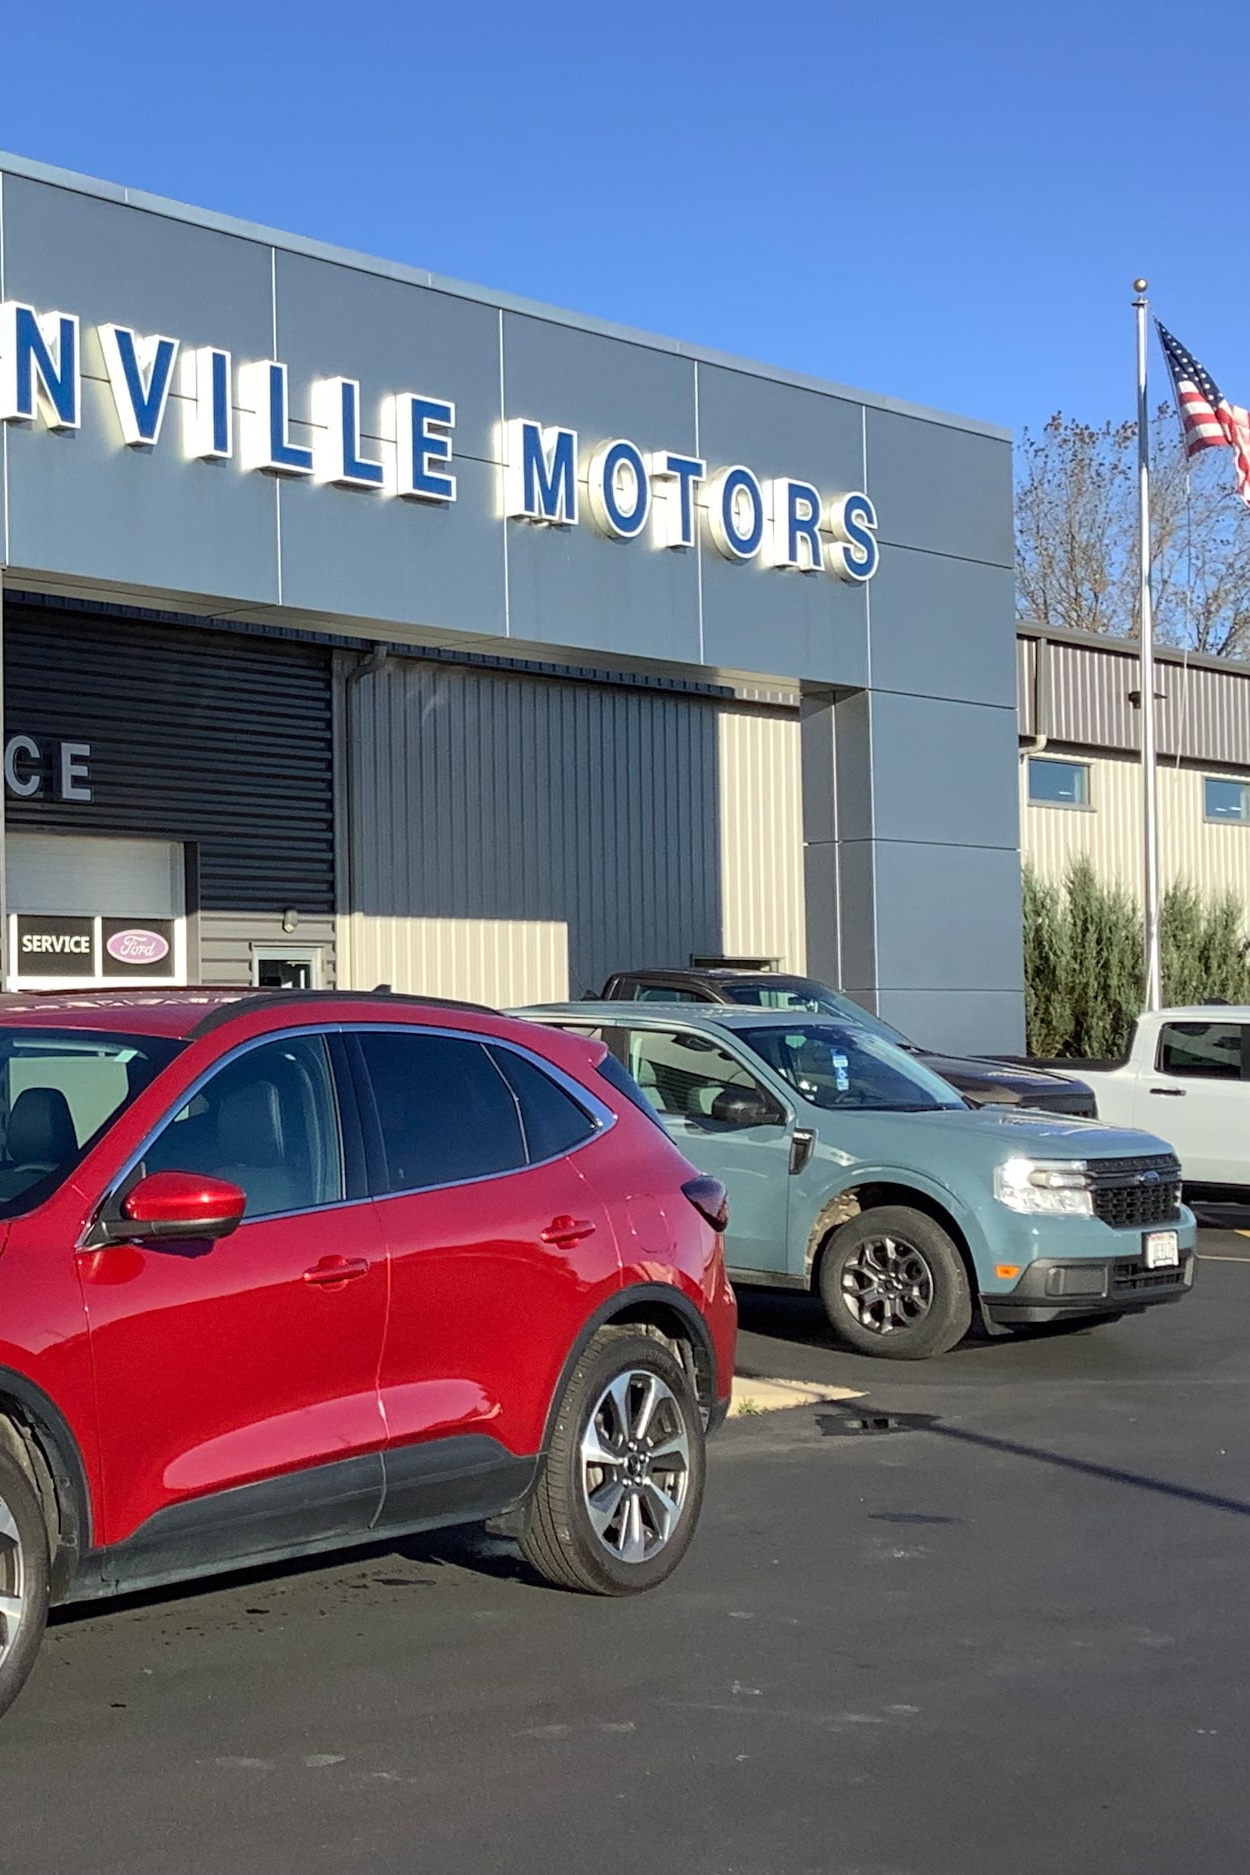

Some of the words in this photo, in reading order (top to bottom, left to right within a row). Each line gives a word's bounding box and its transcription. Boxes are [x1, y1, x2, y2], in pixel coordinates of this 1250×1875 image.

[509, 417, 880, 583] MOTORS
[22, 935, 90, 953] SERVICE
[120, 935, 156, 956] Ford
